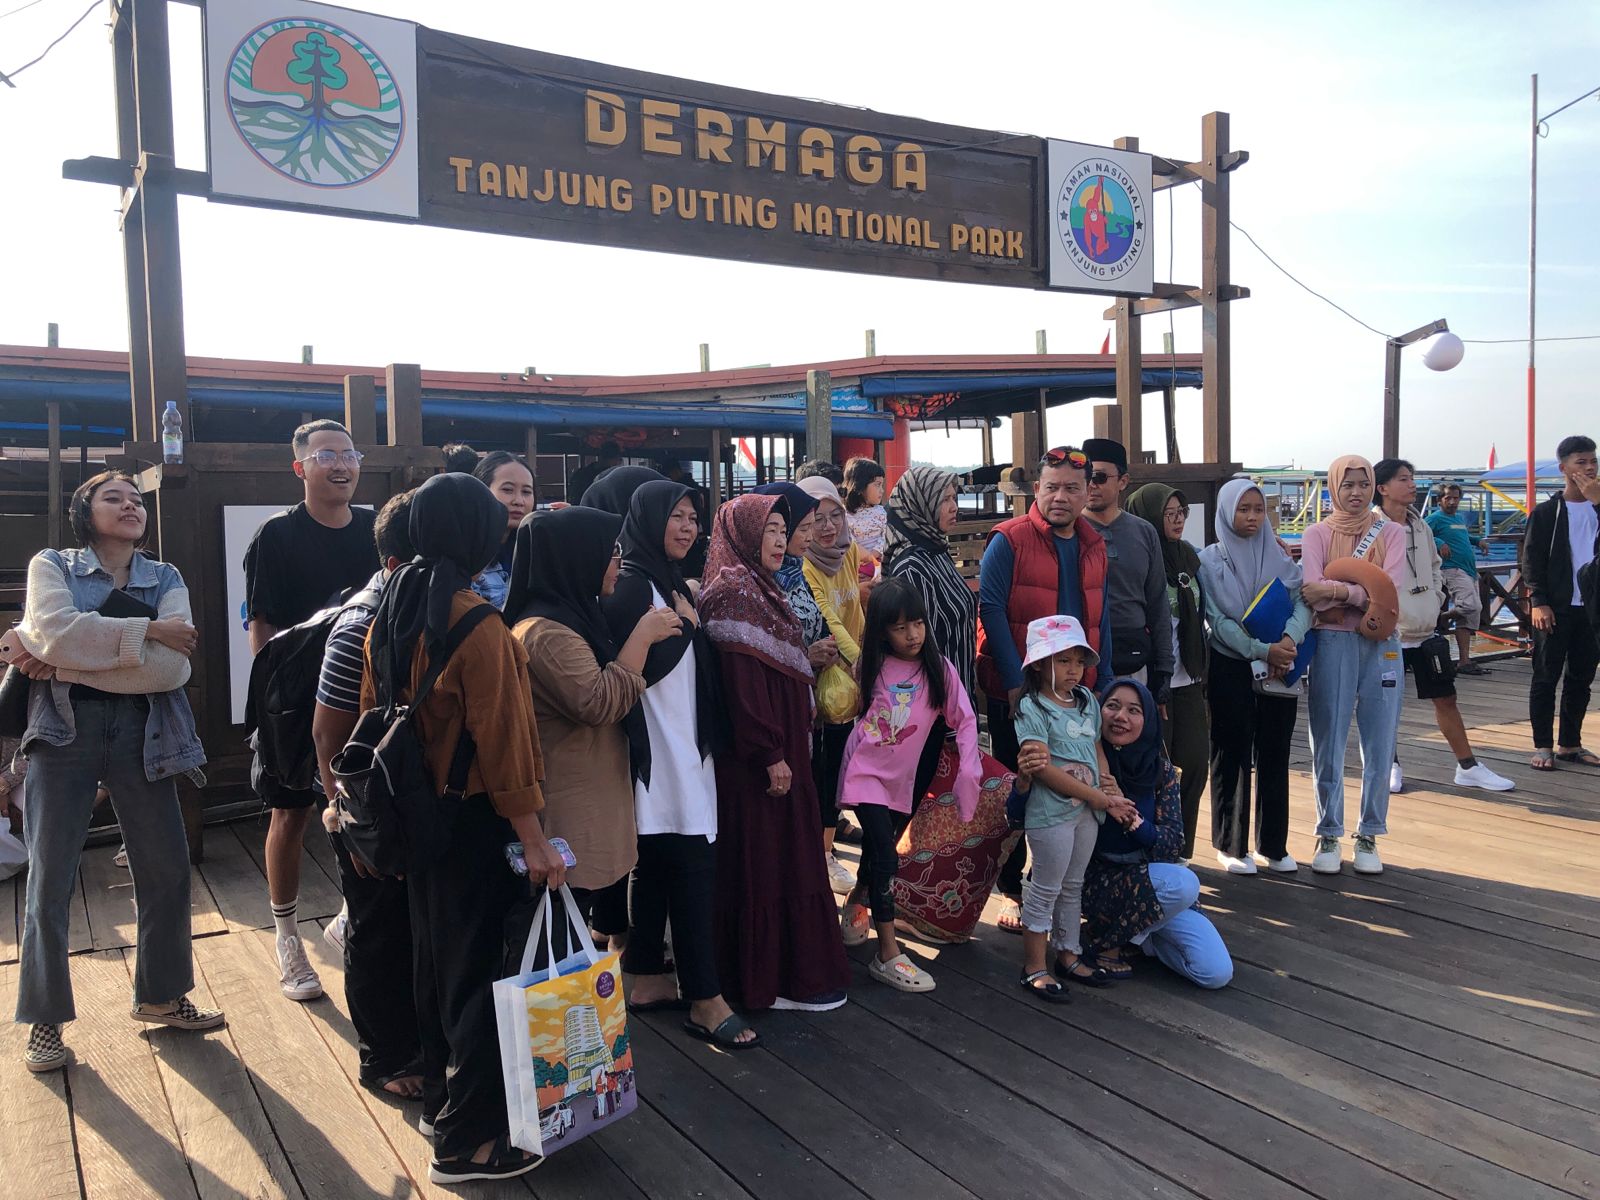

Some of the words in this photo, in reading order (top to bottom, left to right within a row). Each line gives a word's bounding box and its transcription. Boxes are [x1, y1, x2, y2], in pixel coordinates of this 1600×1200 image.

[584, 88, 927, 192] DERMAGA
[449, 156, 633, 212] TANJUNG
[651, 183, 778, 230] PUTING
[793, 202, 940, 249] NATIONAL
[951, 223, 1024, 259] PARK
[1062, 164, 1091, 202] TAMAN
[1095, 163, 1141, 213] NASIONAL
[1063, 229, 1106, 276] TANJUNG
[1110, 238, 1141, 276] PUTING
